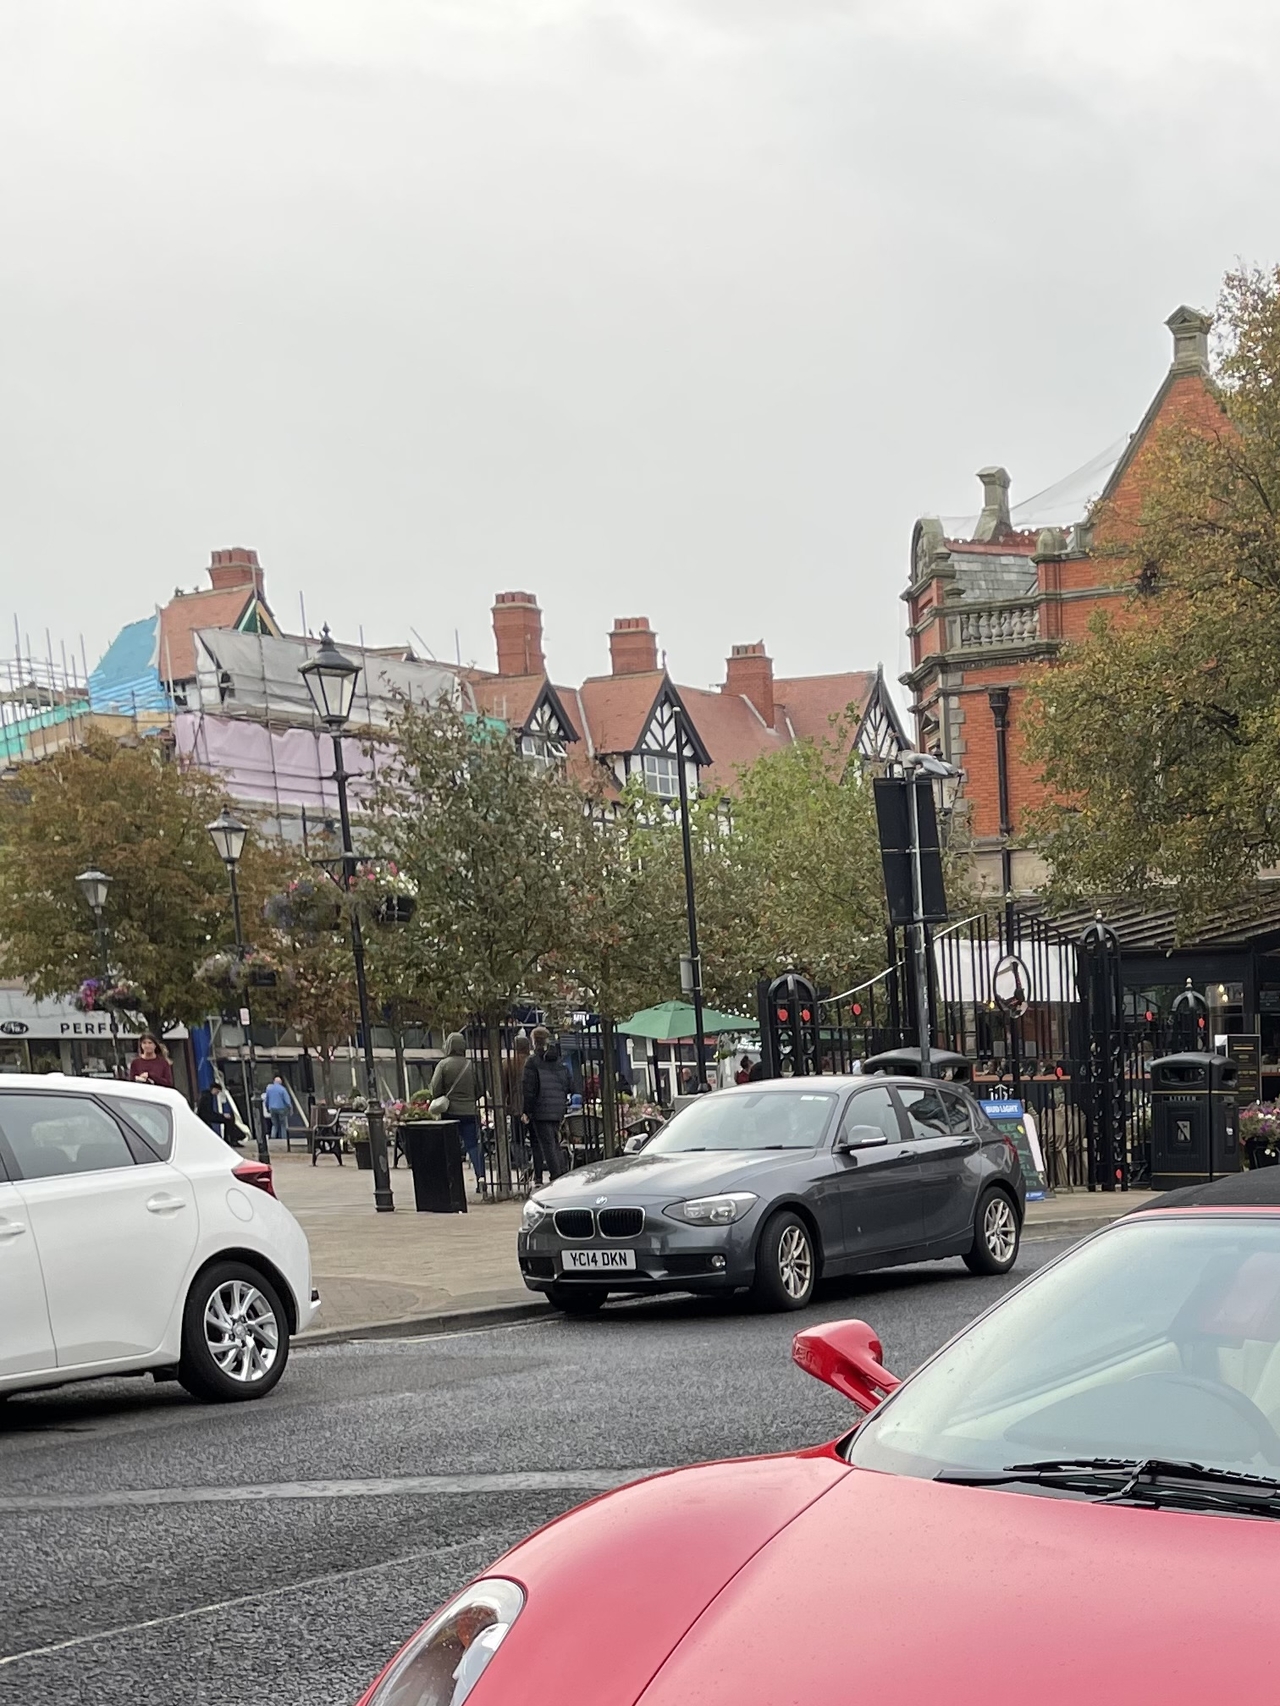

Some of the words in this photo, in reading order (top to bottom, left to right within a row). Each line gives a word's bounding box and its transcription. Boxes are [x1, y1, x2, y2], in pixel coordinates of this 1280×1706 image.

[985, 1105, 1000, 1114] BUD
[1000, 1105, 1018, 1113] LIGHT
[570, 1252, 598, 1267] YC14
[601, 1252, 628, 1266] DKN
